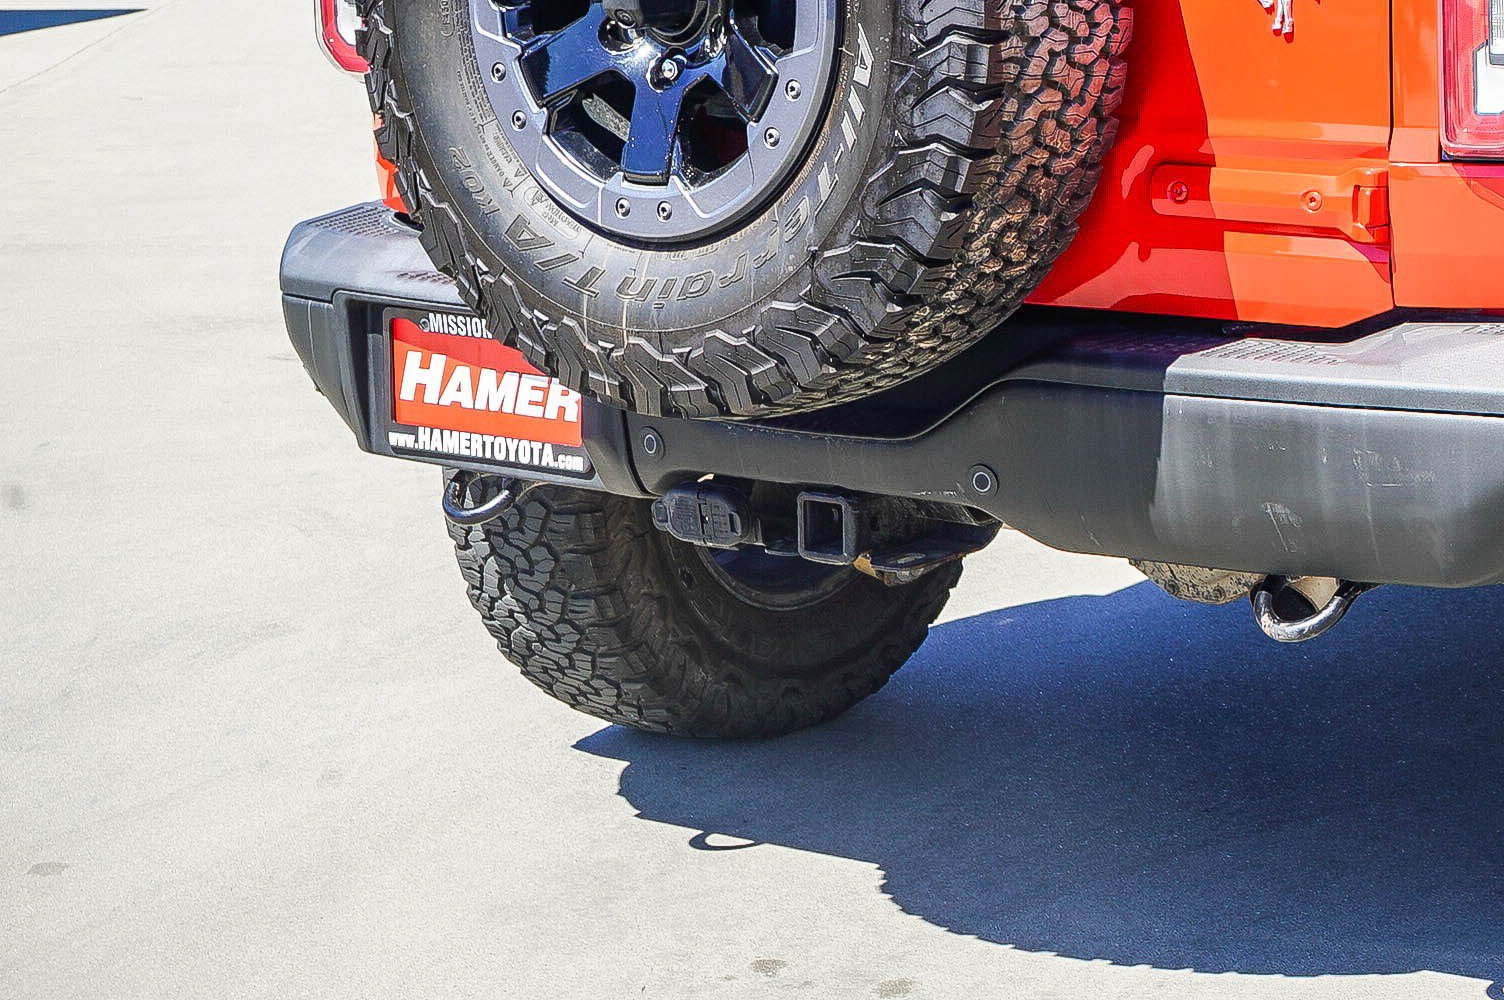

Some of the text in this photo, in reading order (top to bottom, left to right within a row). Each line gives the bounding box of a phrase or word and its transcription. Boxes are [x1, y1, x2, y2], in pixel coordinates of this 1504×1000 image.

[449, 146, 501, 217] KO2
[615, 22, 876, 309] All-Terrain
[503, 213, 607, 299] T/A
[399, 350, 582, 423] HAMER
[388, 426, 585, 472] www.HAMERTOYOTA.com
